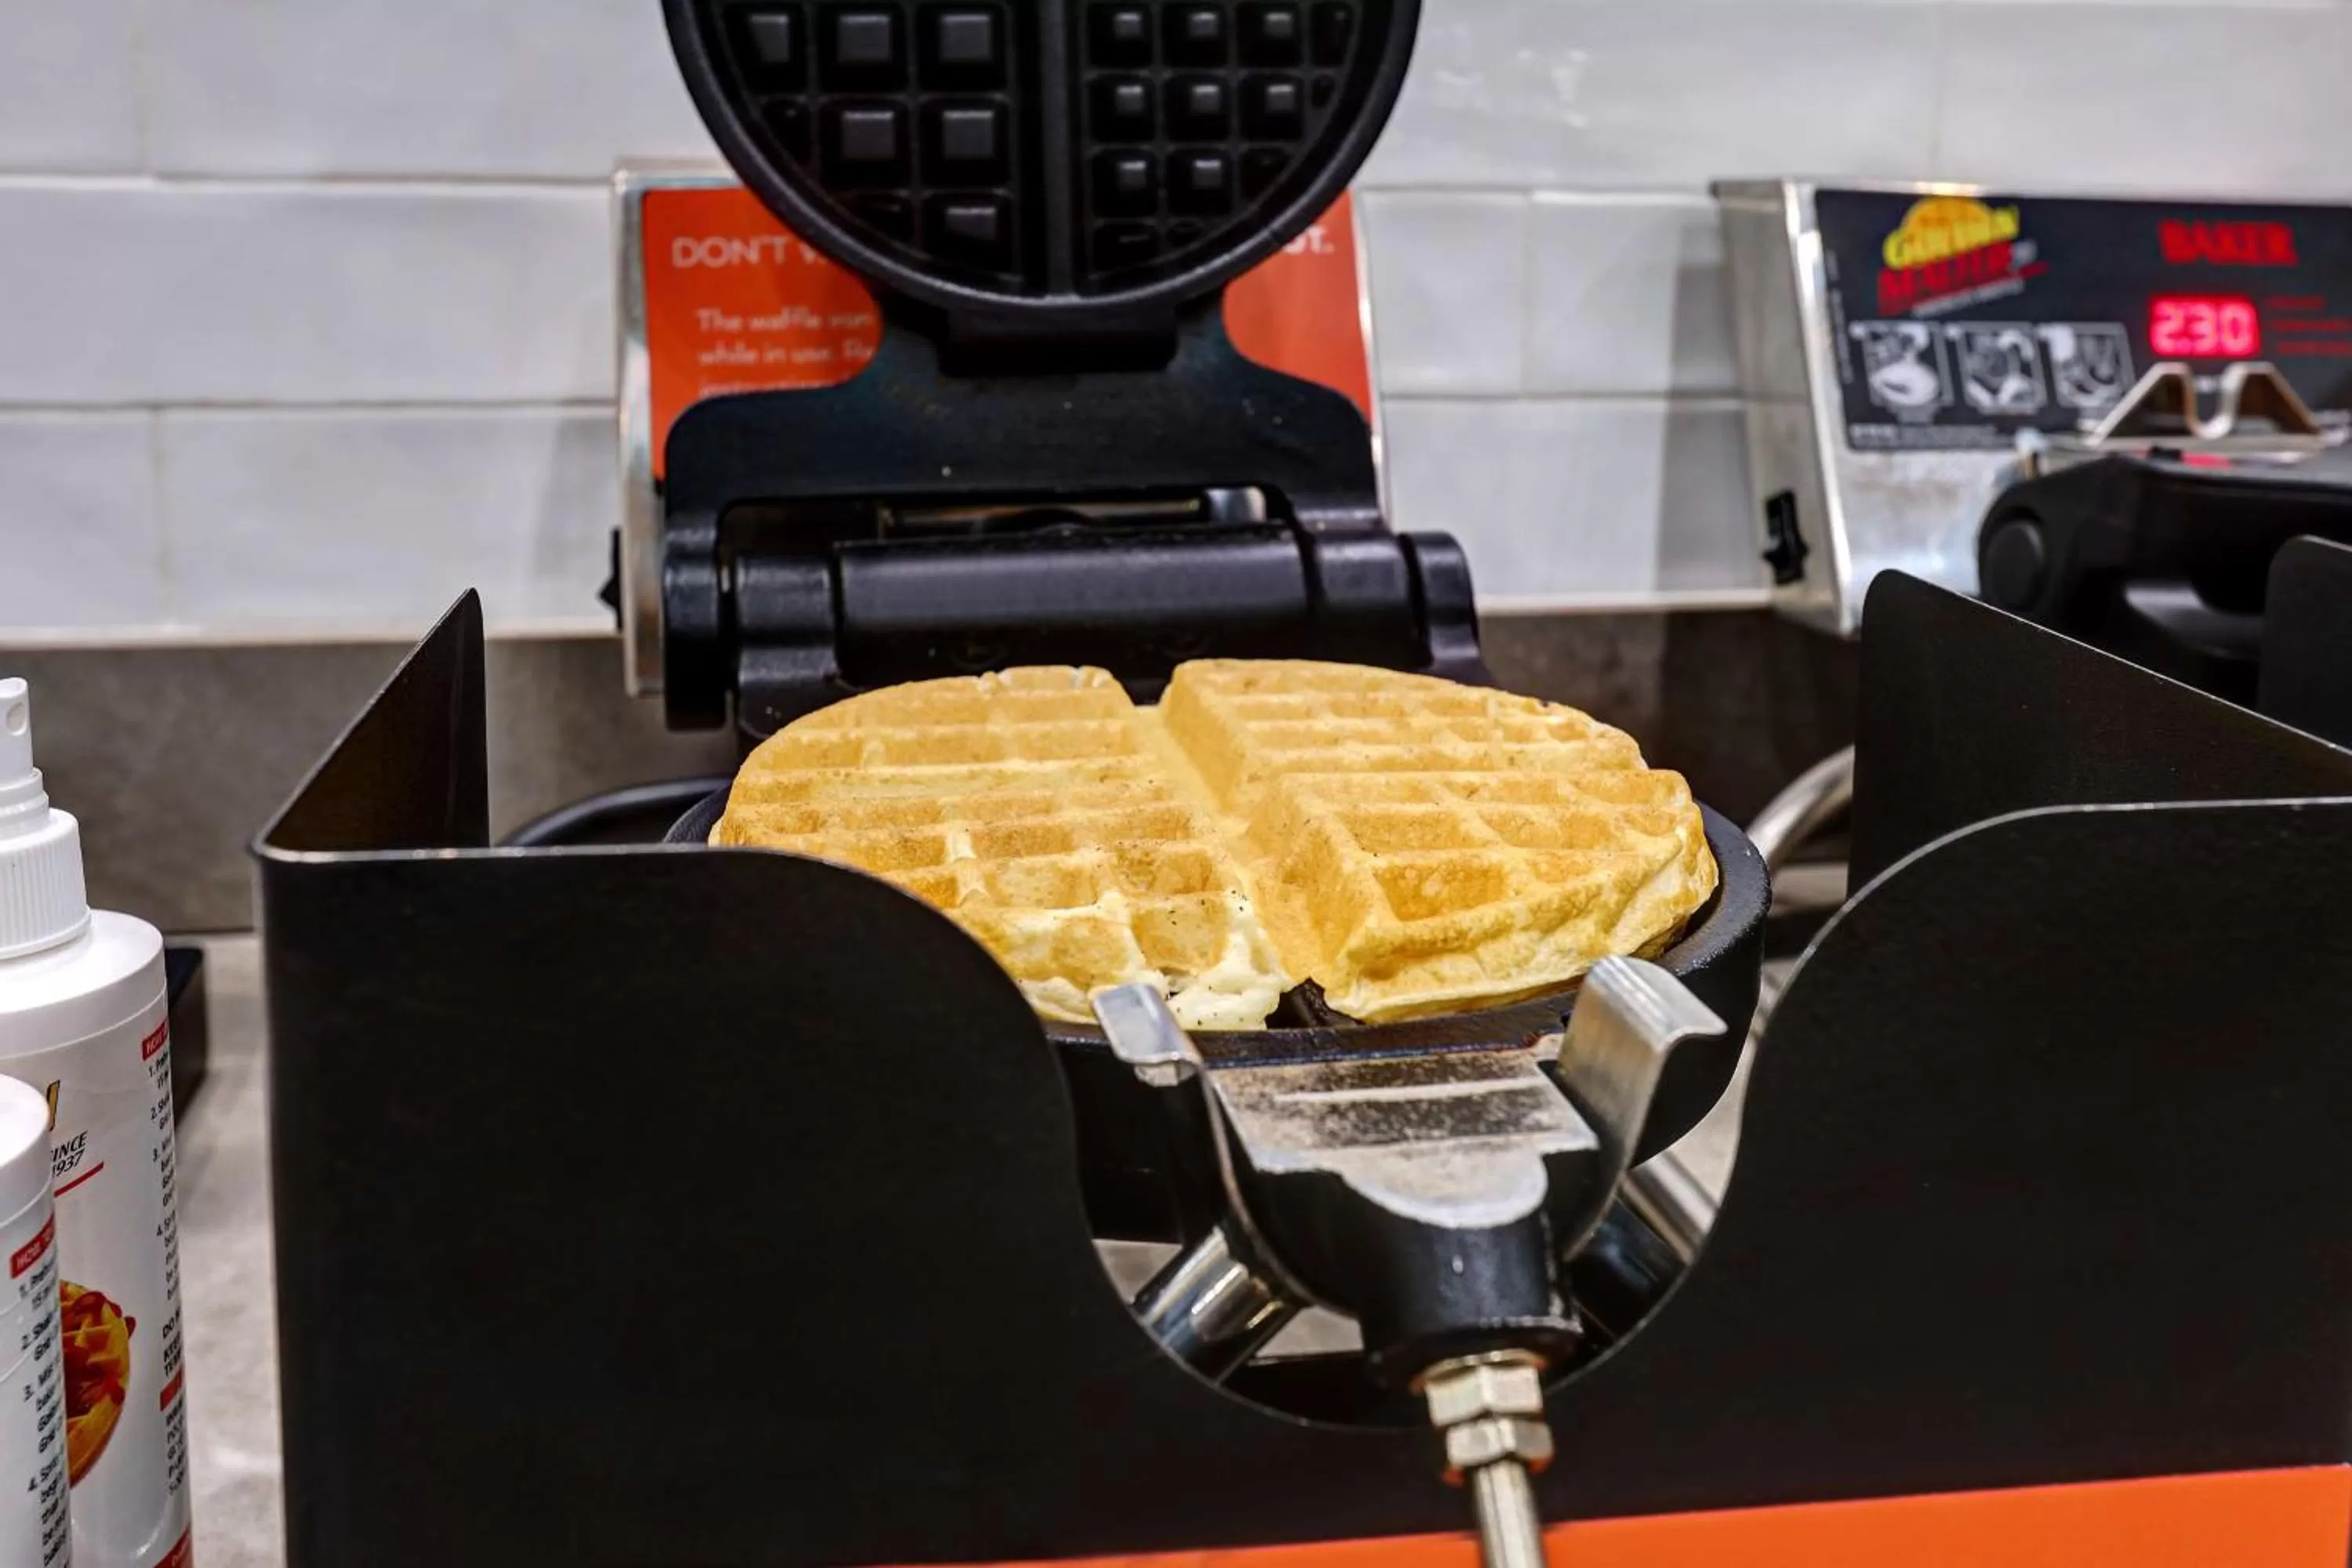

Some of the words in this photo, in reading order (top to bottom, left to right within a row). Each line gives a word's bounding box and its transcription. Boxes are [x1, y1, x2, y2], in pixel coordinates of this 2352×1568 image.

[696, 308, 742, 332] The
[2151, 300, 2253, 356] 230
[50, 1130, 88, 1162] INCE
